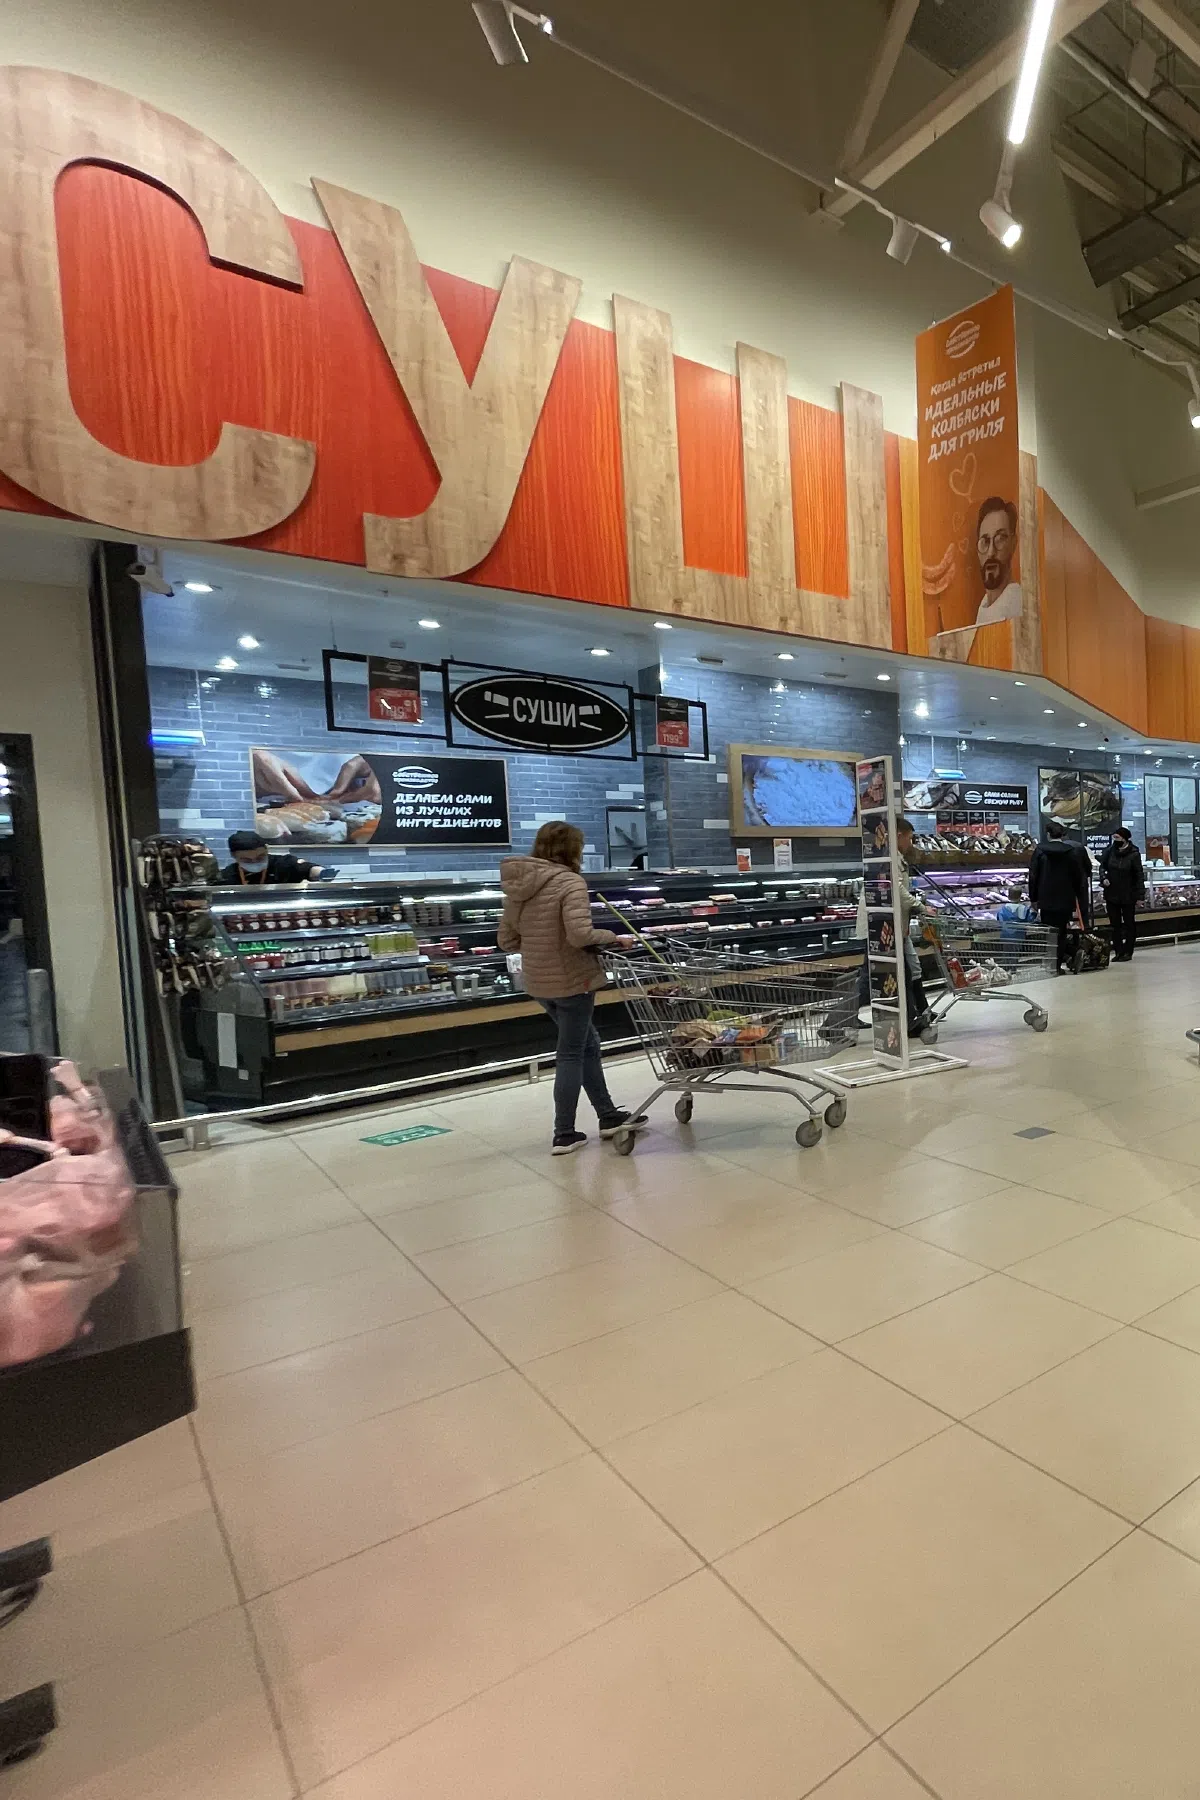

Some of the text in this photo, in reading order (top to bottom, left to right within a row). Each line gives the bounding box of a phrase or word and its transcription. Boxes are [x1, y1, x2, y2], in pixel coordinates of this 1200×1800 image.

[0, 65, 1041, 676] СУШ
[930, 356, 1001, 396] Когда встретил
[925, 371, 1007, 421] ИДЕАЛЬНЫЕ
[931, 396, 1001, 438] КОЛБАСКИ
[927, 416, 1006, 464] ДЛЯ ГРИЛЯ
[512, 696, 577, 728] СУШИ
[393, 793, 493, 804] ДЕЛАЕМ САМИ
[395, 806, 472, 815] ИЗ ЛУЧШИХ
[396, 818, 502, 828] ИНГРЕДИЕНТОВ
